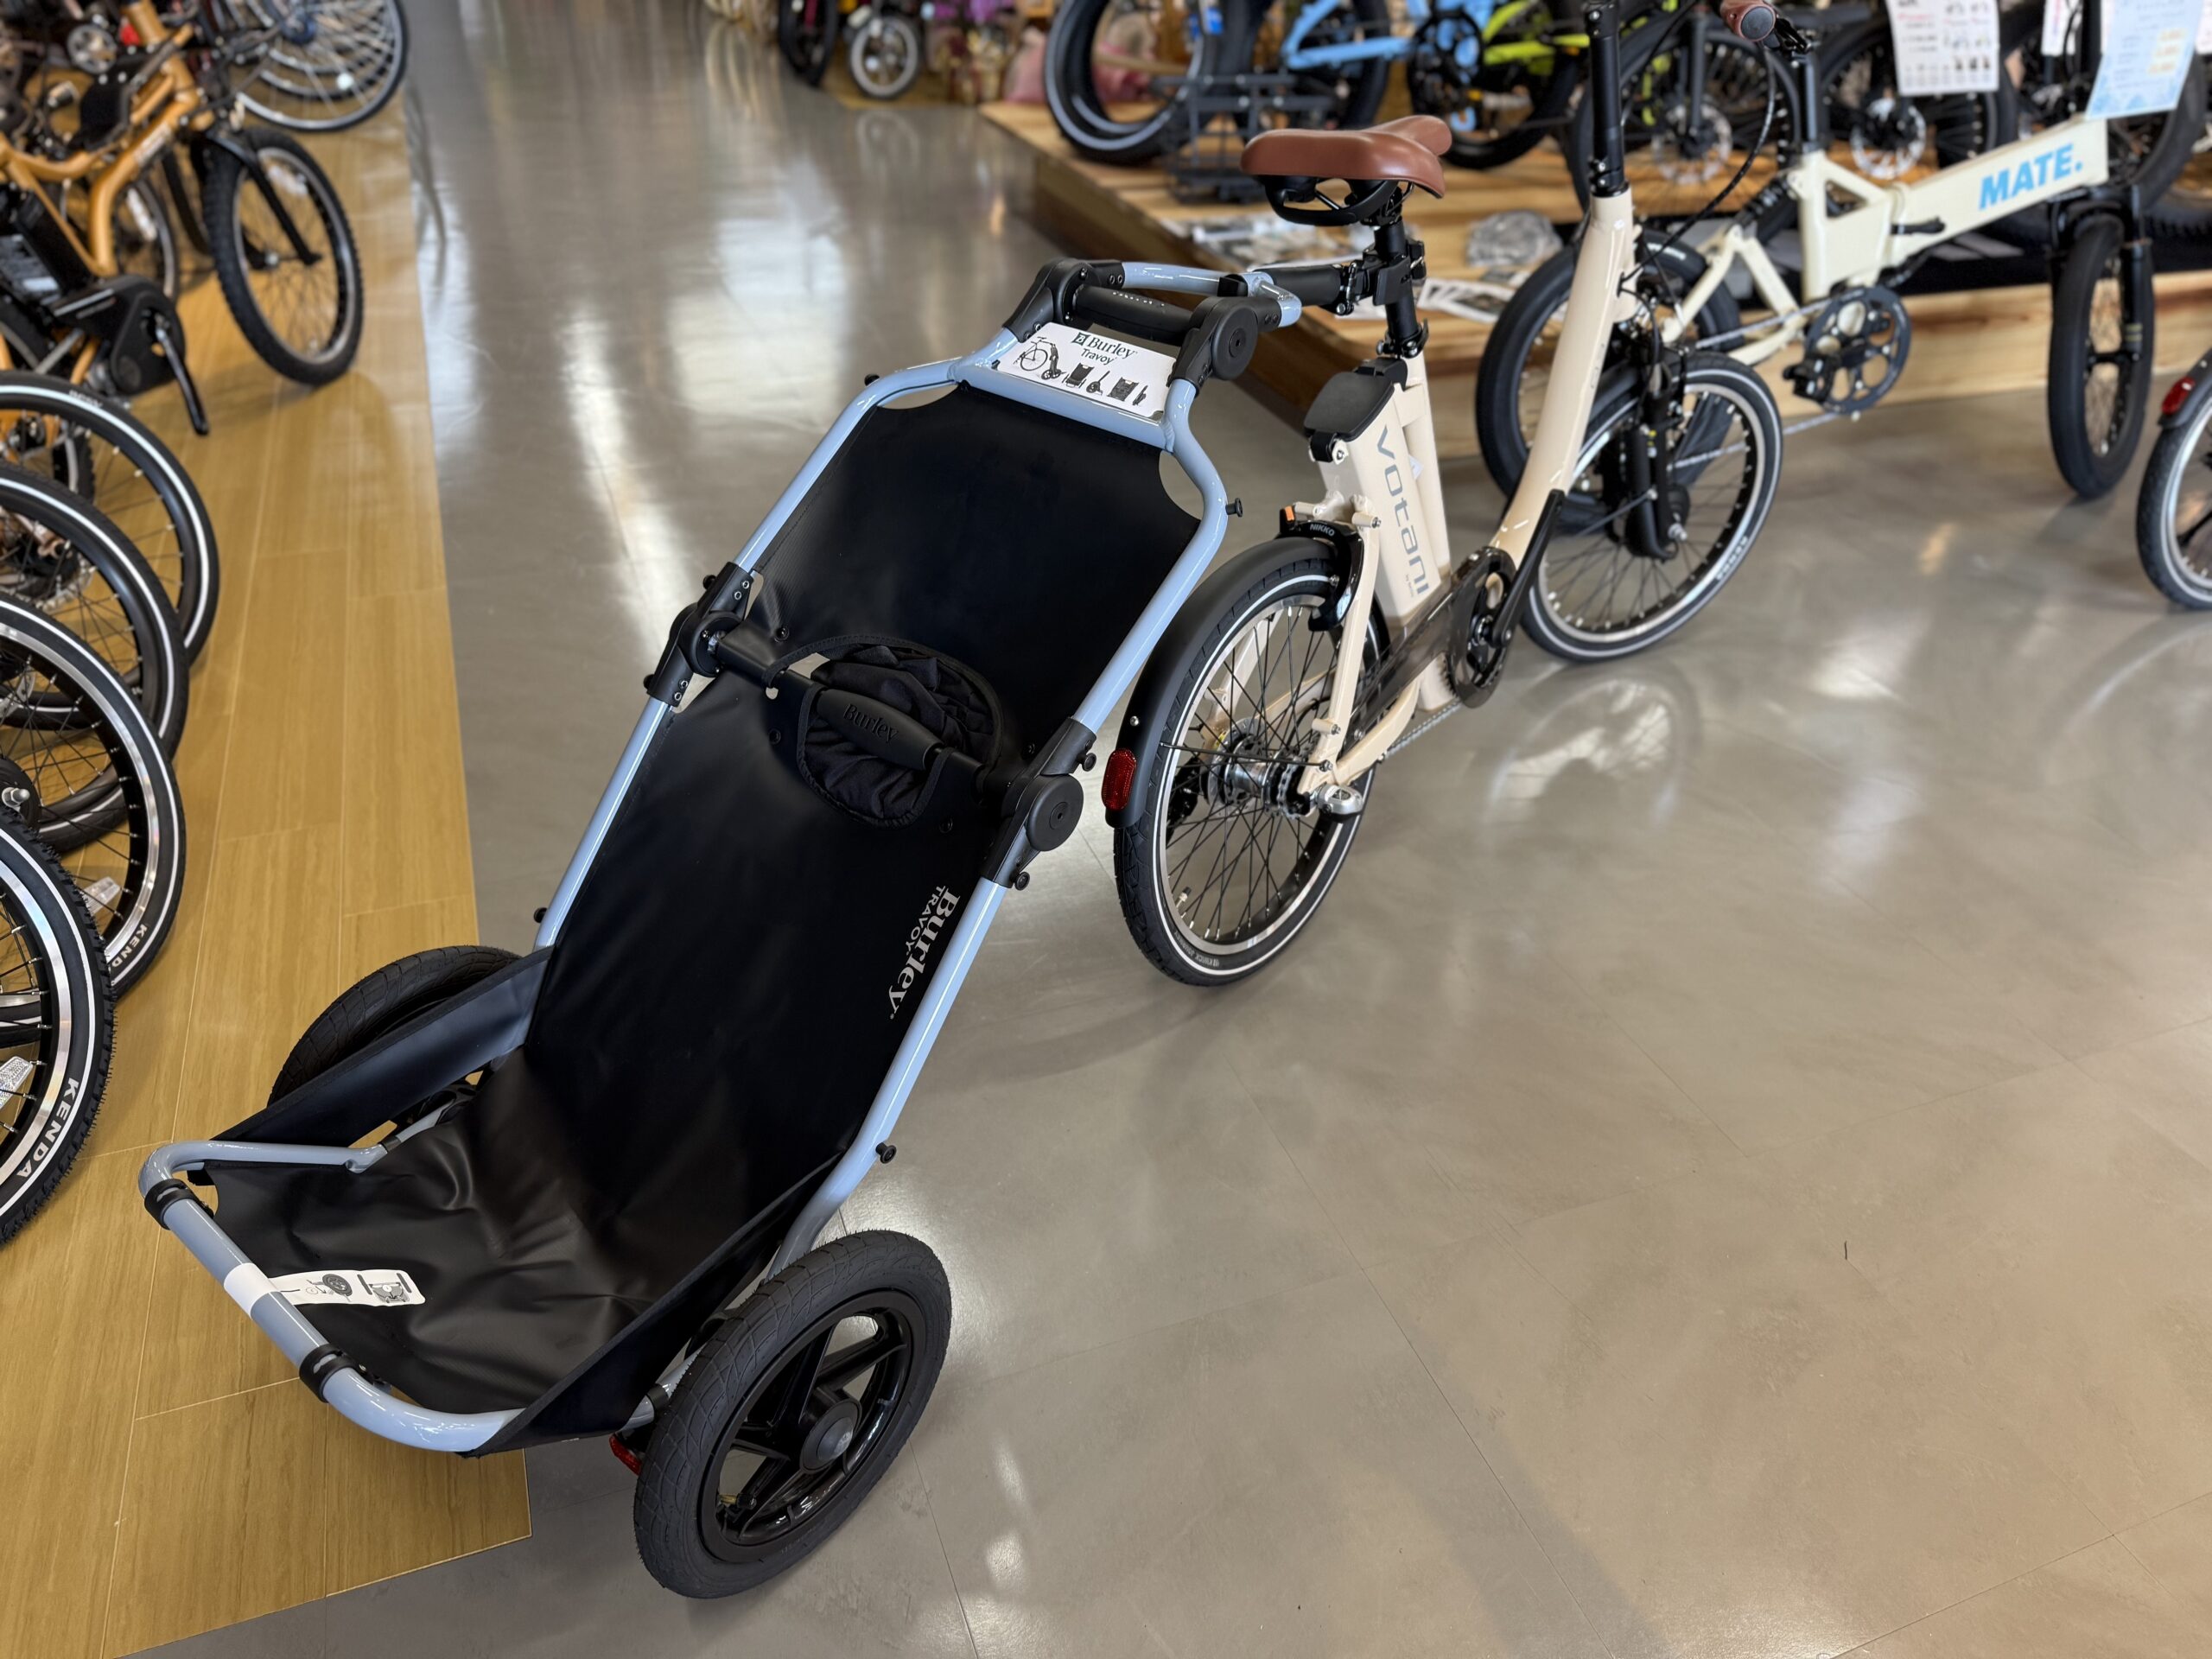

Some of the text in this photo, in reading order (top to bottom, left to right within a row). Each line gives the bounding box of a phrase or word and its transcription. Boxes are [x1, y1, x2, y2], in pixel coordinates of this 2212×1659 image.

[1978, 142, 2083, 211] MATE.
[1081, 348, 1114, 365] Travoy
[1087, 337, 1135, 359] Burley
[1309, 523, 1335, 537] NIKKO
[842, 703, 899, 744] Burley
[906, 885, 946, 953] TRAVOY
[107, 924, 148, 975] KEND
[888, 887, 961, 1014] Burley
[16, 1077, 79, 1179] KENDA
